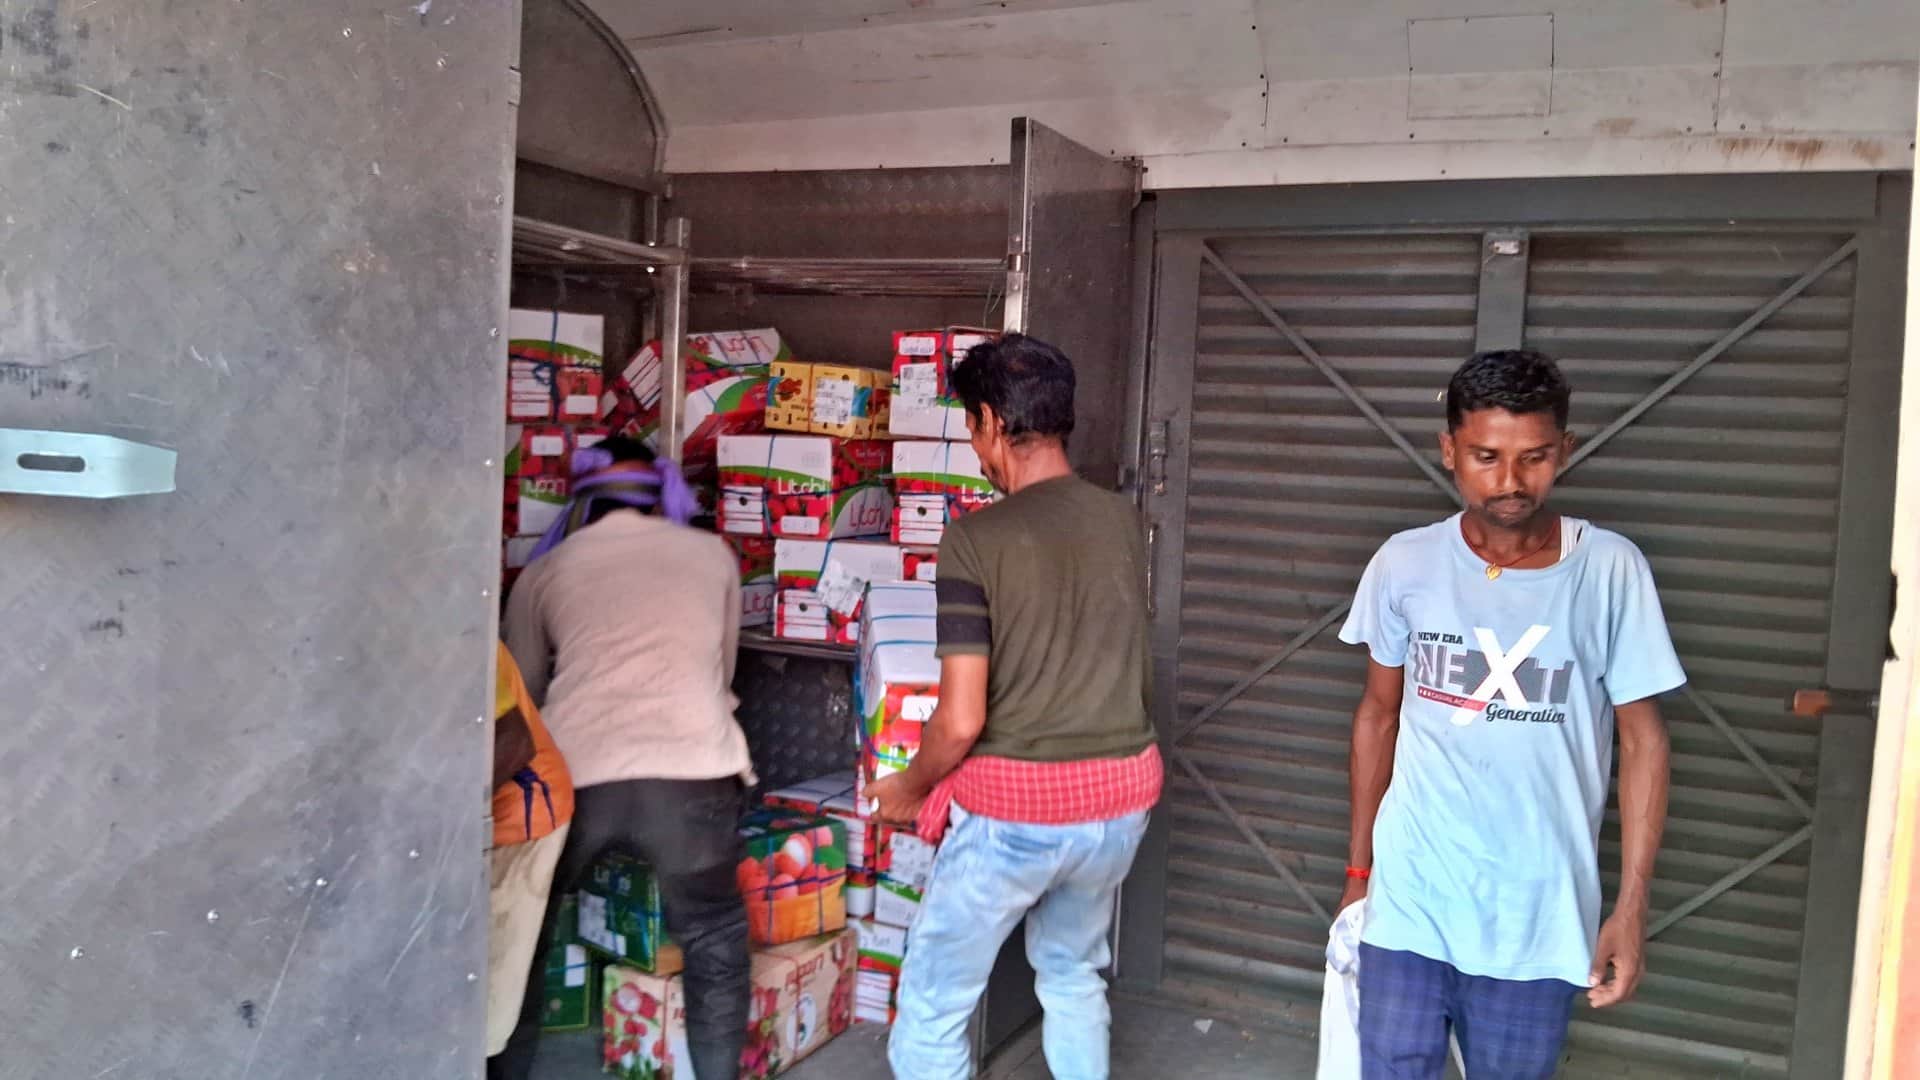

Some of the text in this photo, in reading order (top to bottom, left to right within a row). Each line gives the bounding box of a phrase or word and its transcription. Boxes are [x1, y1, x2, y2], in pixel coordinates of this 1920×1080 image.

[777, 476, 830, 496] Litchi
[1418, 631, 1463, 645] NEW ERA
